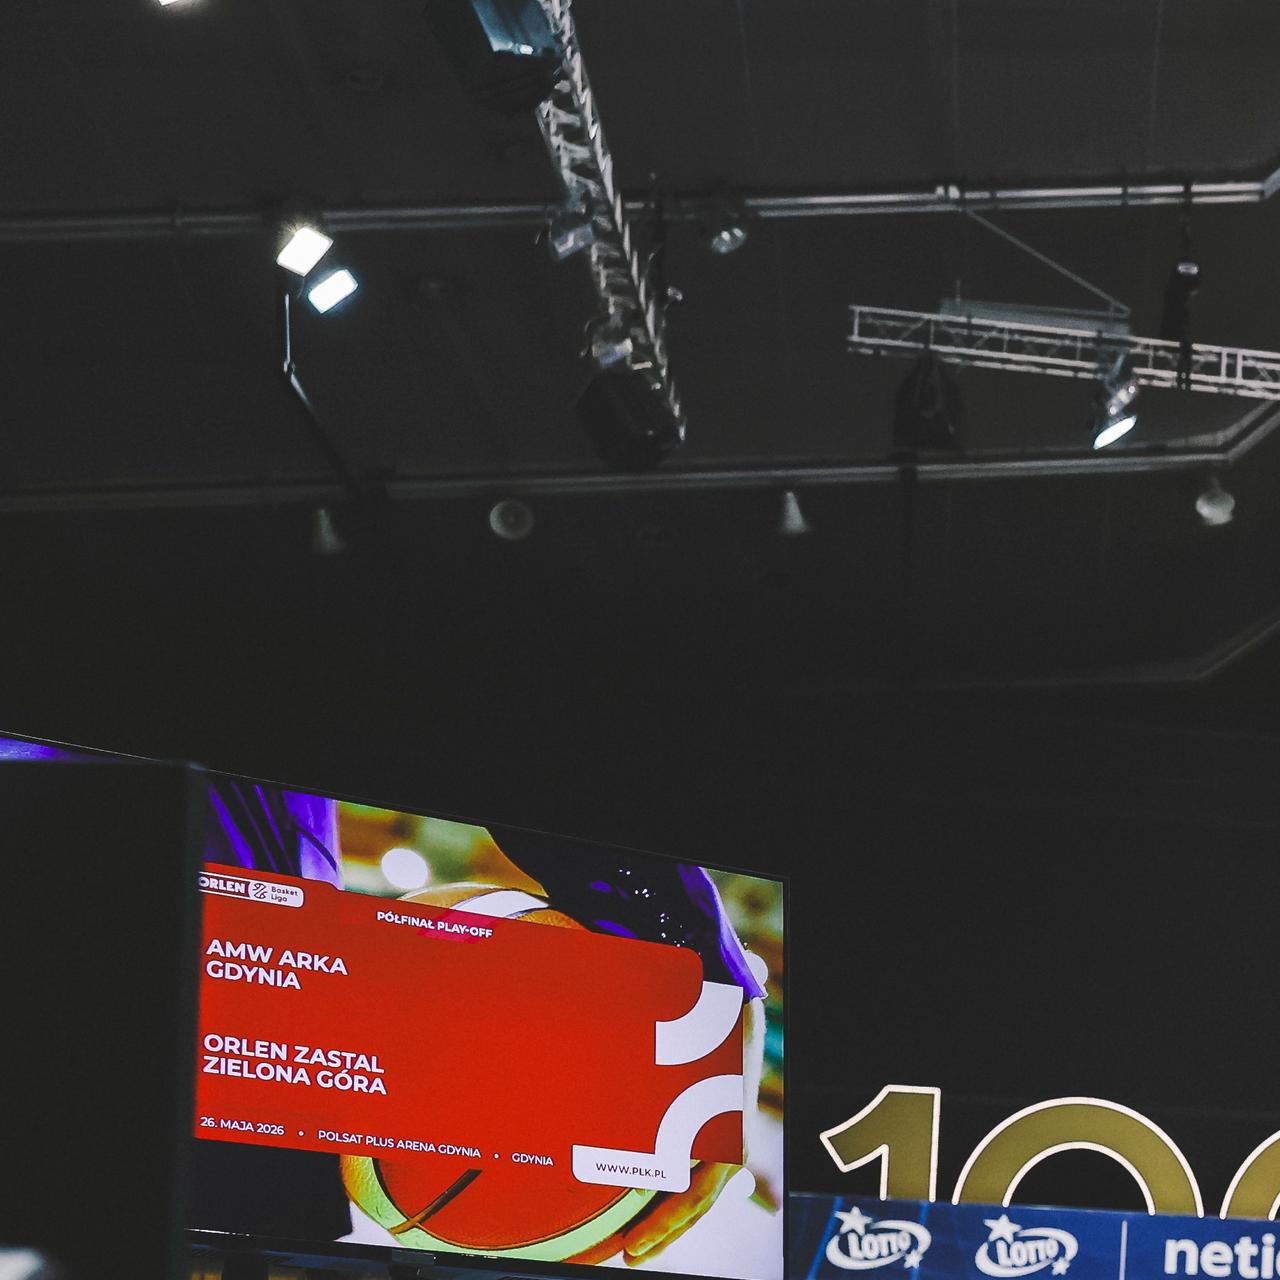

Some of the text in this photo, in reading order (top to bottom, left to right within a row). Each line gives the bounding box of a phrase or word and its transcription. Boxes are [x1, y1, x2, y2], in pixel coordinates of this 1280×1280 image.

[198, 876, 246, 894] ORLEN
[271, 886, 298, 897] Basket
[271, 894, 288, 903] Liga
[377, 910, 493, 938] PÓŁFINAŁ PLAY-OFF
[206, 939, 348, 975] AMW ARKA
[206, 960, 301, 990] GDYNIA
[203, 1033, 385, 1074] ORLEN ZASTAL
[203, 1055, 387, 1096] ZIELONA GÓRA
[200, 1117, 554, 1167] 26. MAJA 2026 POLSAT PLUS ARENA GDYNIA GDYNIA
[595, 1162, 668, 1180] WWW.PLK.PL
[847, 1231, 911, 1260] LOTTO
[995, 1238, 1059, 1267] LOTTO
